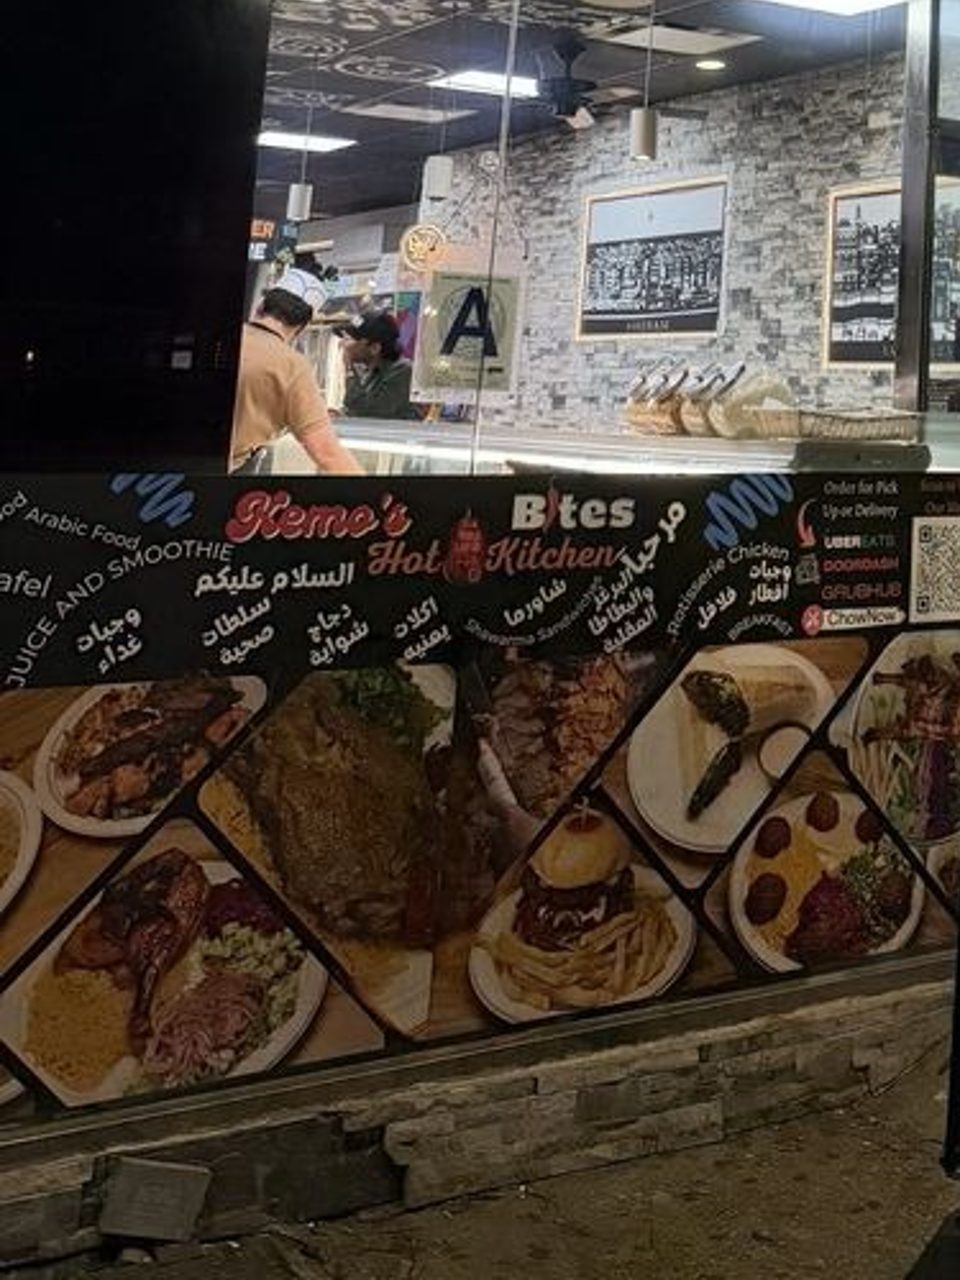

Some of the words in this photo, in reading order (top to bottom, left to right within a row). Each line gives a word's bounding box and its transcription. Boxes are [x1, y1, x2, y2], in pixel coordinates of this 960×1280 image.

[440, 285, 499, 358] A
[511, 484, 637, 532] Bites
[823, 480, 856, 496] Order
[24, 506, 89, 537] Arabic
[91, 523, 142, 551] Food
[225, 489, 413, 544] Kemo's
[367, 539, 446, 577] Hot
[485, 537, 618, 576] Kitchen
[726, 541, 791, 564] Chicken
[822, 556, 900, 572] DOORDASH
[193, 564, 265, 598] عليكم
[270, 561, 355, 595] السلام
[821, 582, 902, 600] GRUBHUB
[6, 615, 58, 689] JUICE
[55, 571, 104, 619] AND
[107, 539, 236, 579] SMOOTHIE
[502, 577, 568, 627] شاورما
